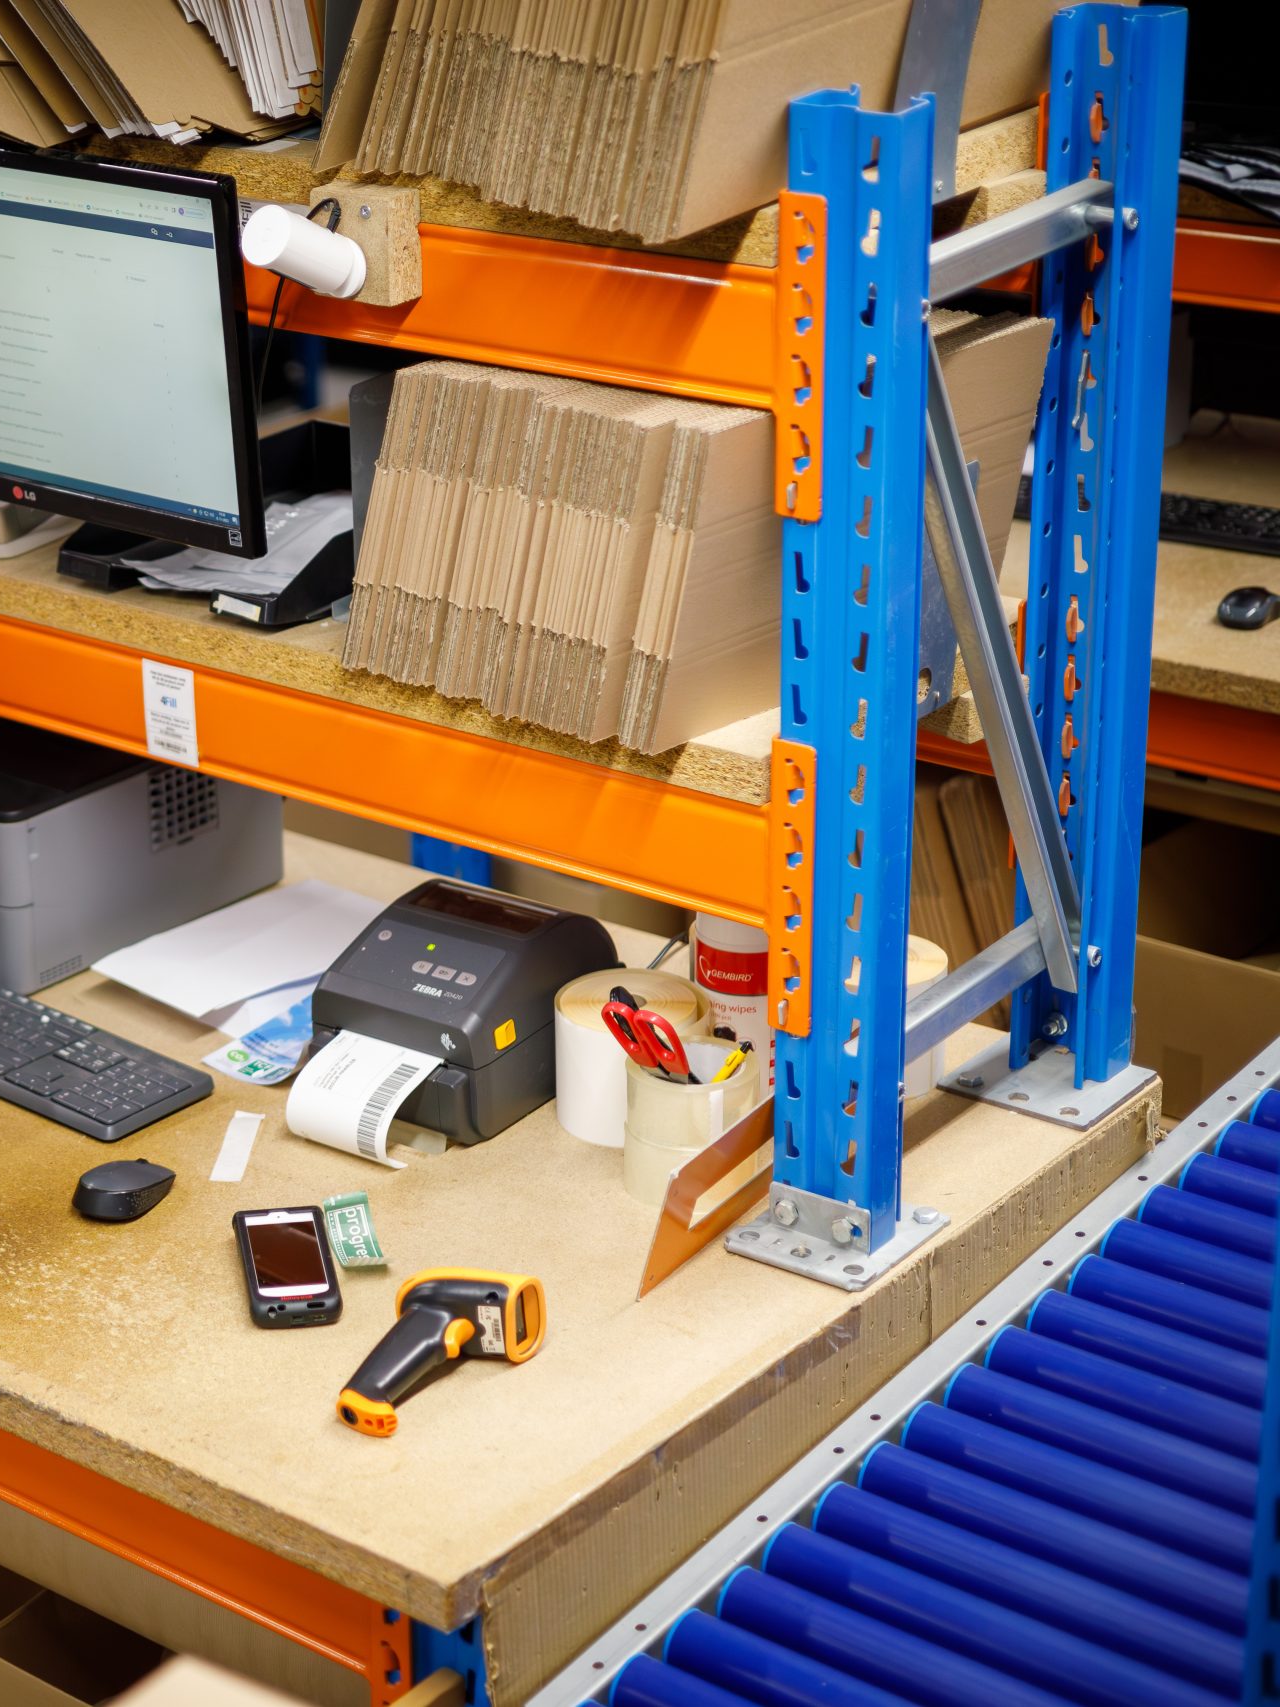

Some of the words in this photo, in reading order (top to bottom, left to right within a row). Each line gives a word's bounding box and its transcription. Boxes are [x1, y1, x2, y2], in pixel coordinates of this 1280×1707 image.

[24, 490, 36, 501] LG
[711, 968, 752, 983] GEMBIRD
[412, 983, 443, 998] ZEBRA
[728, 1004, 757, 1014] wipes
